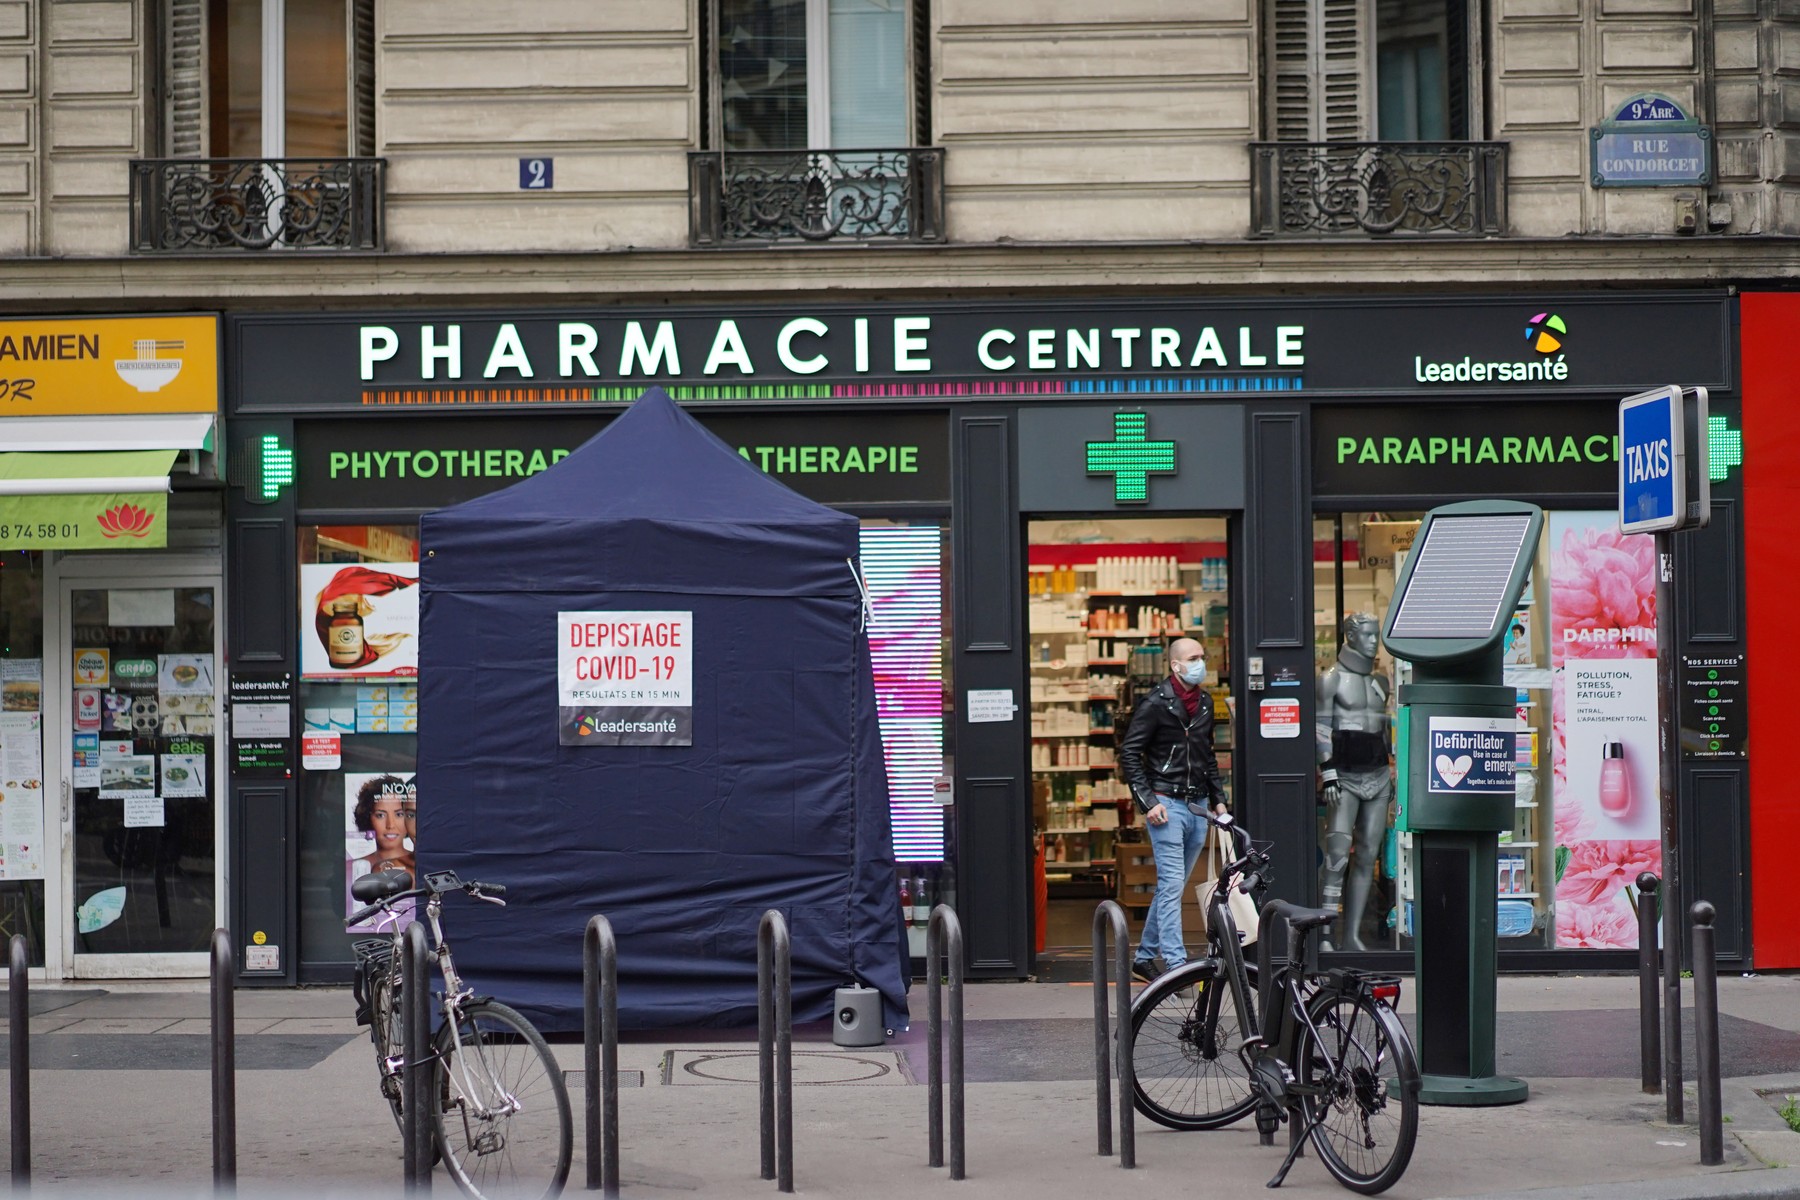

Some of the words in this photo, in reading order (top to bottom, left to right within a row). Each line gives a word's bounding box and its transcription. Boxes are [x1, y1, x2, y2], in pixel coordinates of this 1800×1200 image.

[1633, 139, 1669, 153] RUE
[1602, 158, 1699, 172] CONDORCET
[528, 159, 545, 188] 2
[0, 334, 99, 360] AMIEN
[360, 316, 932, 381] PHARMACIE
[977, 325, 1306, 371] CENTRALE
[1415, 354, 1569, 382] leadersanté
[1626, 438, 1670, 484] TAXIS
[14, 524, 33, 539] 74
[38, 524, 57, 539] 58
[61, 524, 79, 538] 01
[570, 623, 681, 647] DEPISTAGE
[576, 656, 675, 680] COVID-19
[1577, 671, 1632, 679] POLLUTION,
[1577, 681, 1613, 690] STRESS,
[572, 690, 627, 699] RESULTATS
[630, 690, 644, 699] EN
[647, 690, 659, 699] 15
[661, 690, 680, 699] MIN
[595, 718, 677, 733] leadersanté
[170, 741, 206, 754] eats
[1435, 733, 1504, 750] Defibrillator
[1473, 750, 1484, 758] Use
